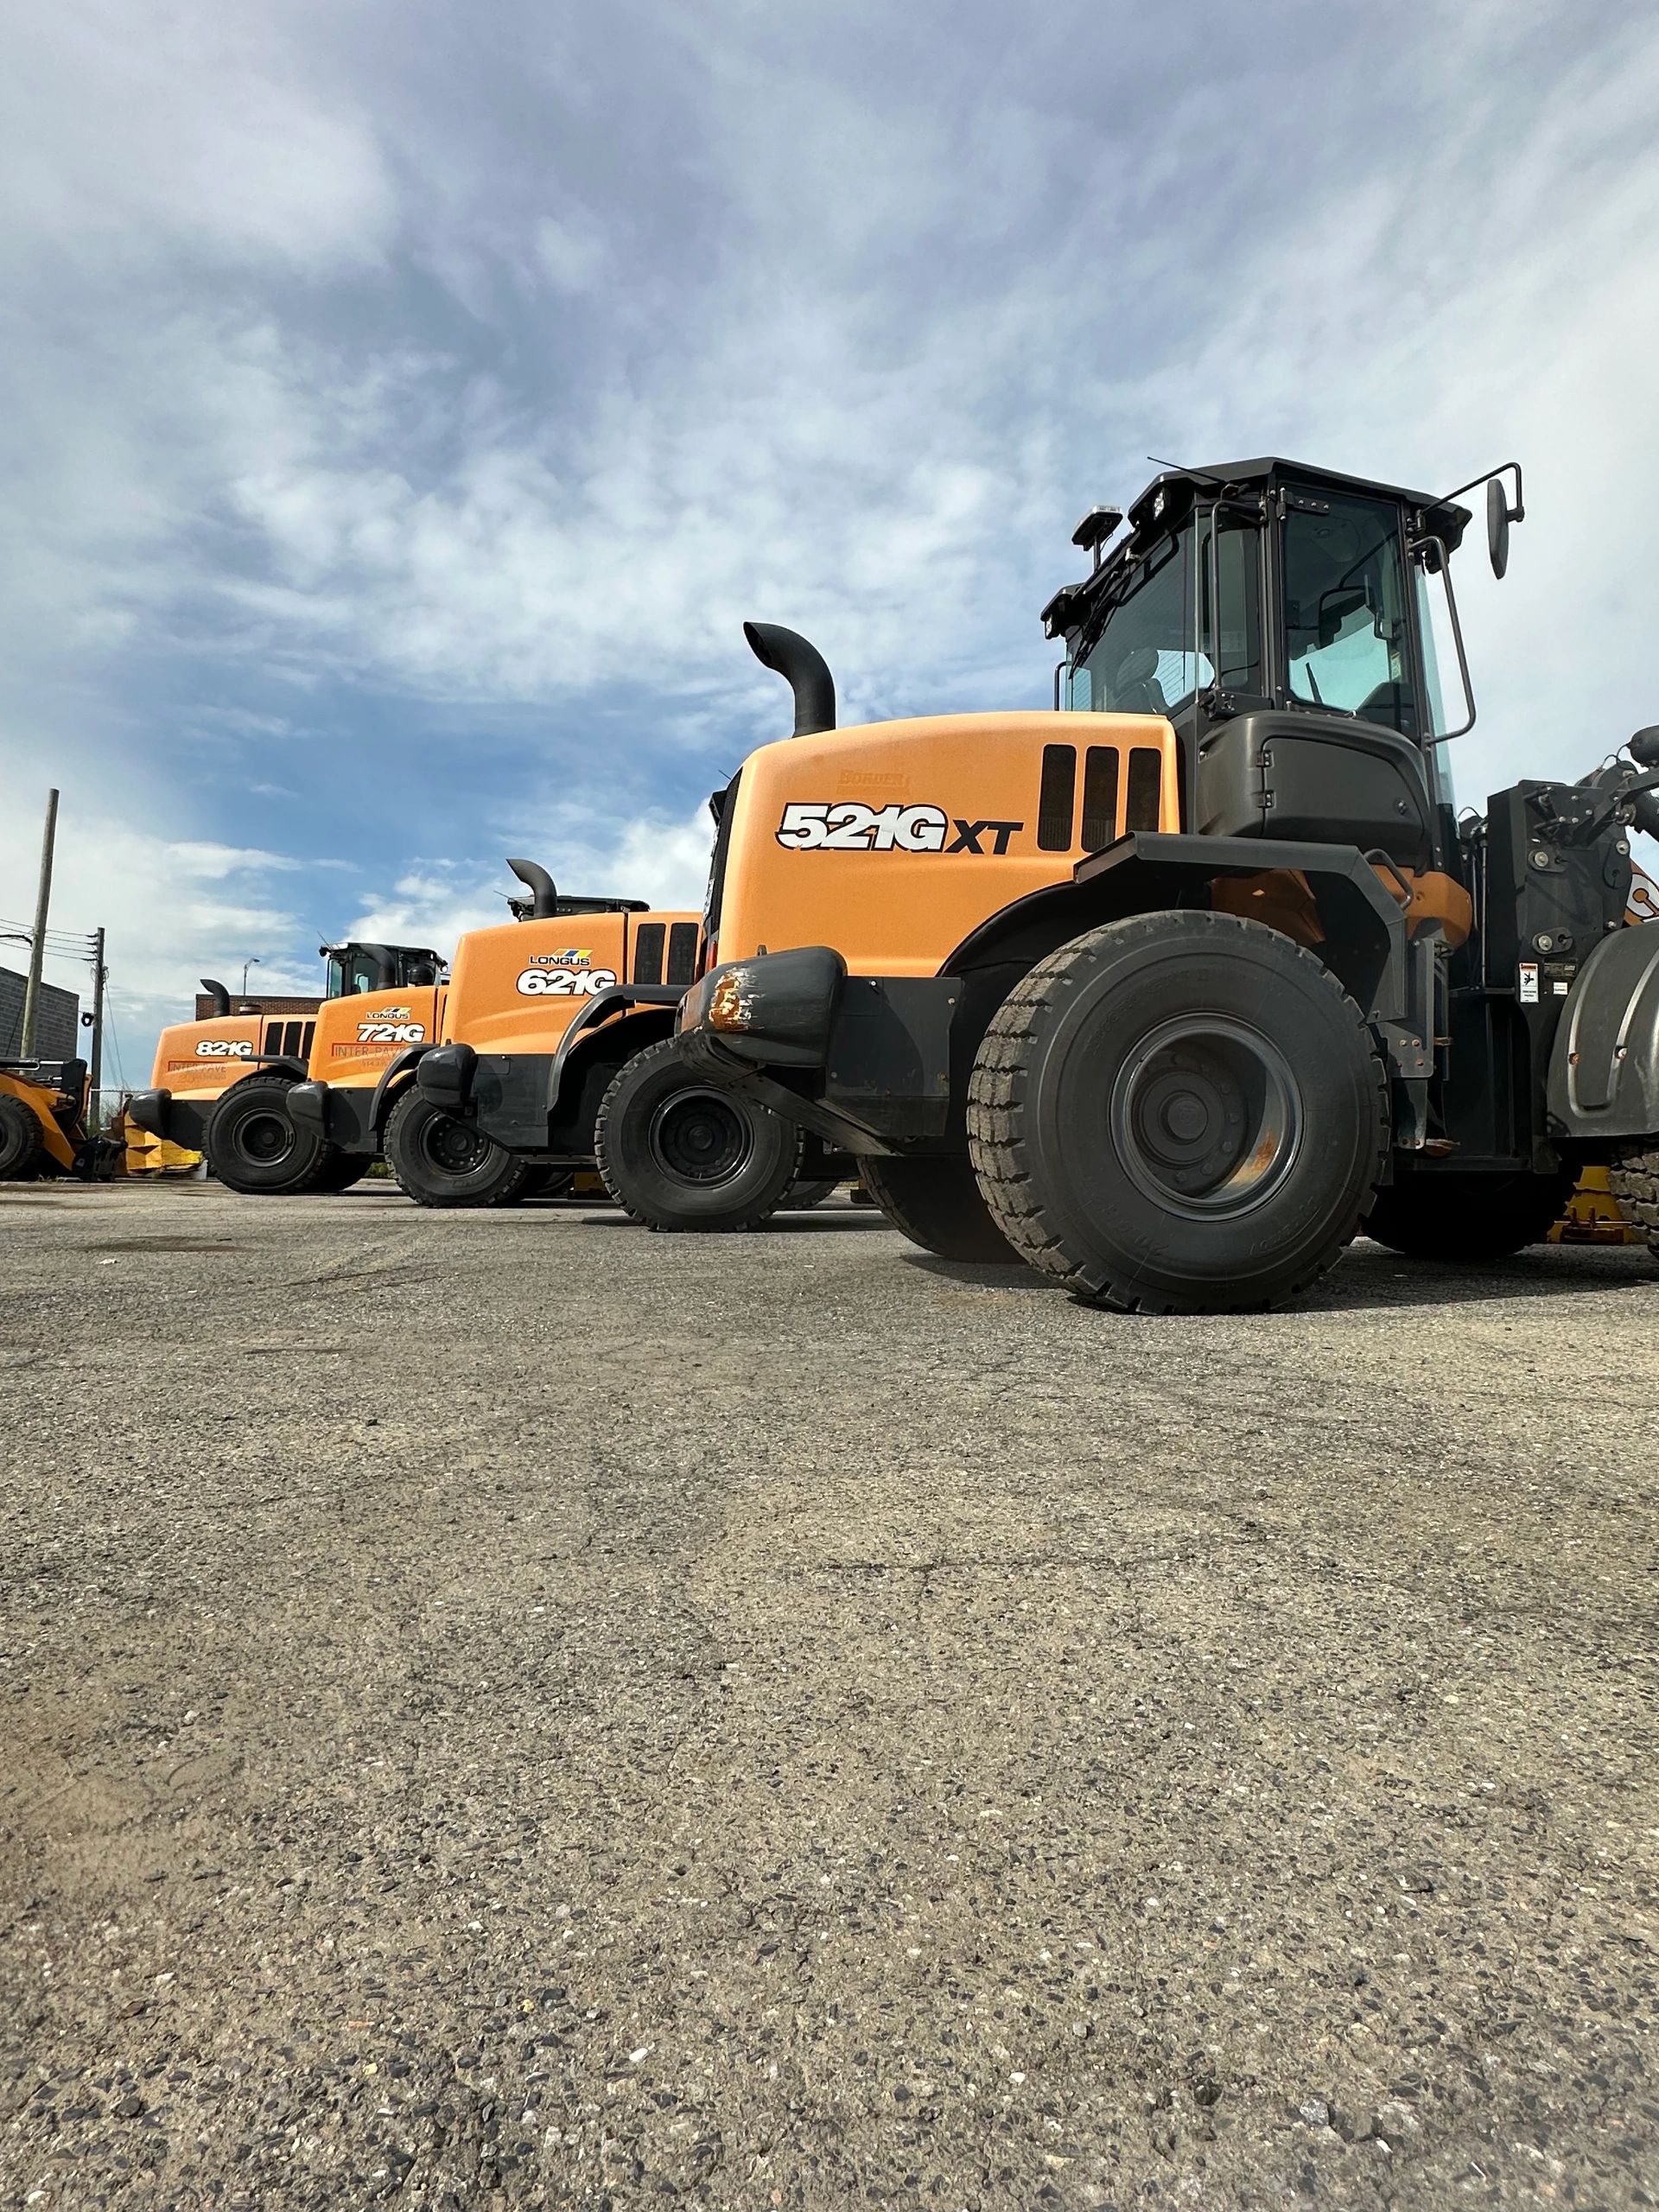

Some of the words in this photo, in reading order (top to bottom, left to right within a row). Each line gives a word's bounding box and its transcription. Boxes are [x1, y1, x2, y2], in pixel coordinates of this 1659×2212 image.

[775, 802, 948, 853] 521G
[944, 819, 1024, 855] XT
[530, 956, 590, 966] LONGUS
[516, 968, 617, 995] 621G
[356, 1022, 426, 1042] 721G
[194, 1039, 254, 1057] 821G
